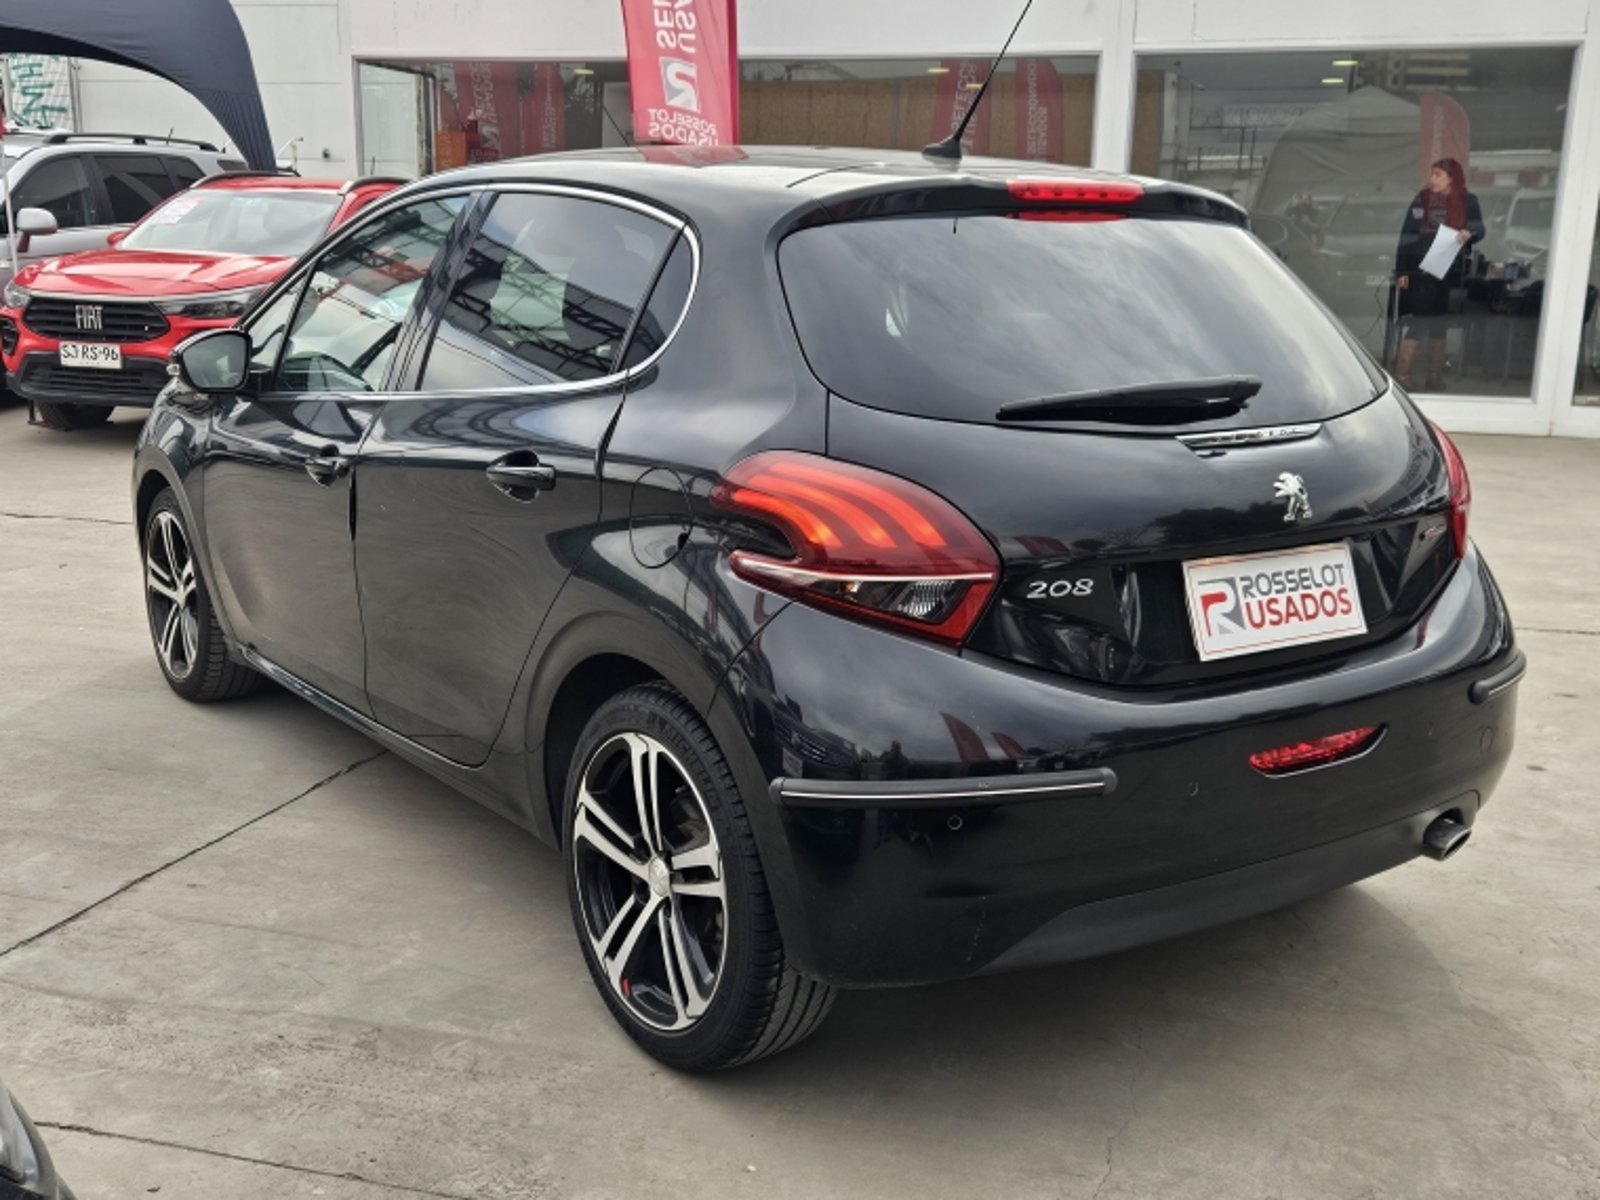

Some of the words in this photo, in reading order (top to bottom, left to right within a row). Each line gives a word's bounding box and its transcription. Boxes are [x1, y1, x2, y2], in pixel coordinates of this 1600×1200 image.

[75, 304, 103, 330] FIAT
[1027, 579, 1094, 598] 208
[1240, 564, 1344, 598] ROSSELOT
[1245, 588, 1352, 629] USADOS
